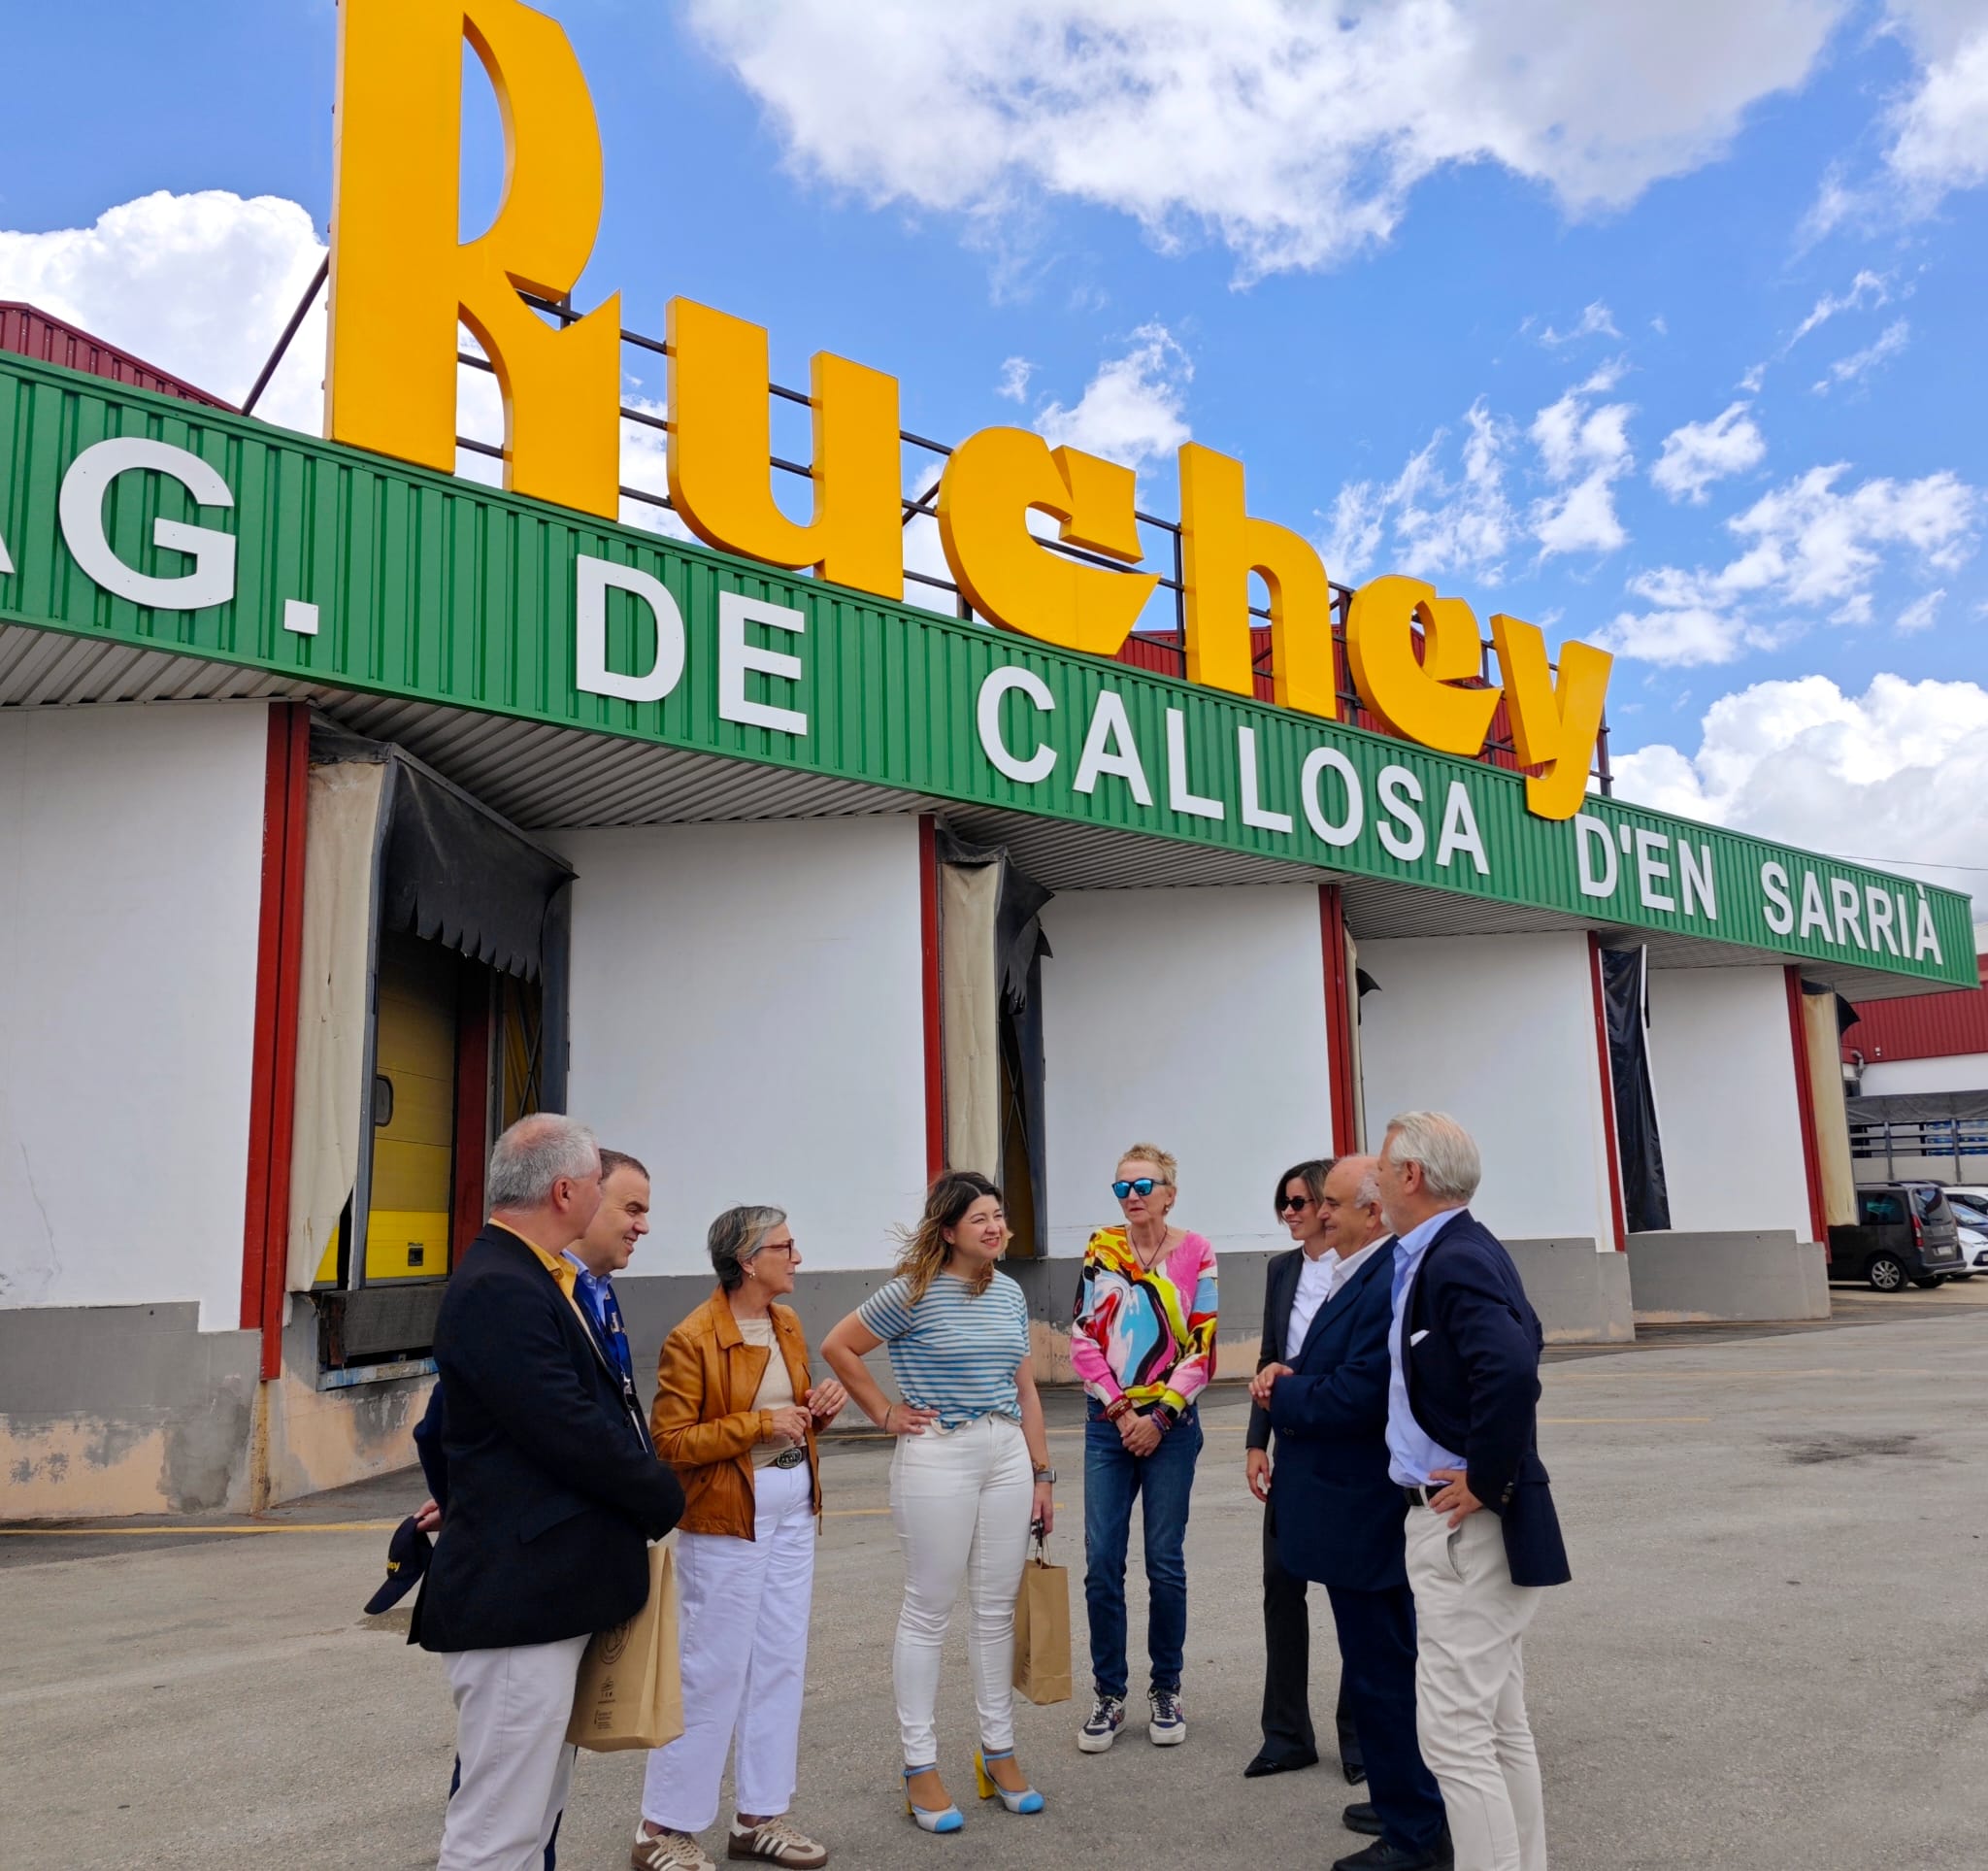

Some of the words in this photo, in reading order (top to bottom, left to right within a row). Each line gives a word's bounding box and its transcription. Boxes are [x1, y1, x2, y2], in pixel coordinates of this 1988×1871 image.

[0, 436, 319, 635] G.
[576, 553, 808, 736] DE
[977, 665, 1490, 875] CALLOSA
[1574, 813, 1717, 920] D'EN
[1760, 860, 1943, 965] SARRIÀ
[325, 0, 1613, 820] Ruchey
